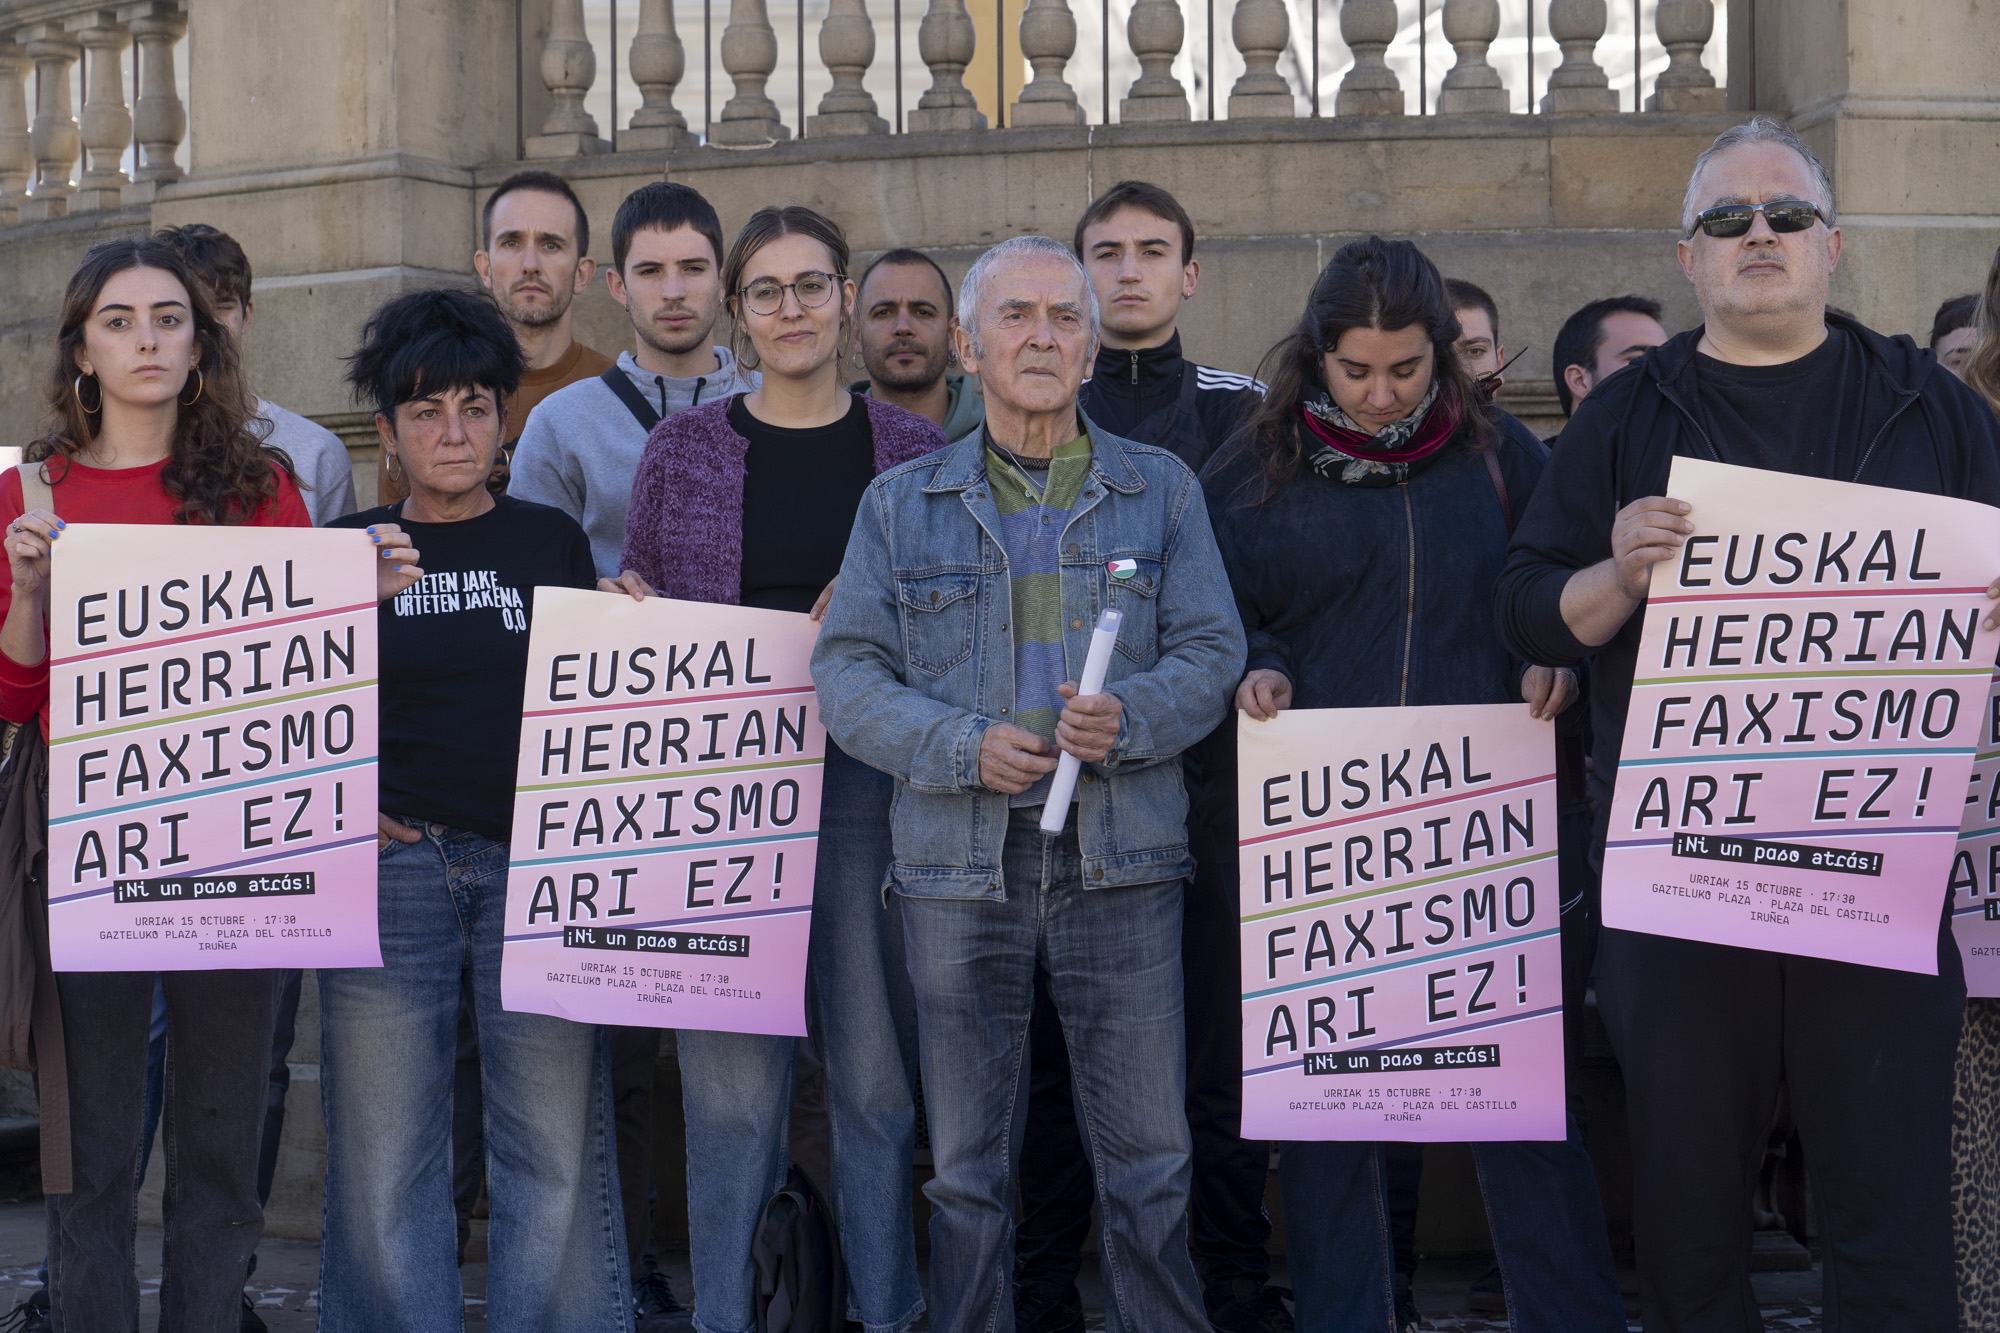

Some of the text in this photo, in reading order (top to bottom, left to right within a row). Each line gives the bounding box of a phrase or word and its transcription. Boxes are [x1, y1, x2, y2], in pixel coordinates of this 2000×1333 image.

[1678, 528, 1941, 588] EUSKAL
[462, 570, 498, 592] JAKE
[77, 559, 314, 647] EUSKAL
[394, 586, 523, 616] URTETEN JAKENA
[1662, 608, 1980, 670] HERRIAN
[75, 625, 354, 727] HERRIAN
[548, 638, 771, 703] EUSKAL
[1651, 688, 1960, 750] FAXISMO
[77, 704, 354, 805] FAXISMO
[541, 705, 807, 777] HERRIAN
[1262, 735, 1492, 828] EUSKAL
[1634, 772, 1763, 831] ARI
[1813, 767, 1933, 821] EZ!
[73, 781, 344, 884] ARI EZ!
[537, 778, 800, 851] FAXISMO
[1263, 798, 1534, 905] HERRIAN
[1677, 835, 1878, 871] ¡Ni un paso atrás!
[118, 874, 311, 901] ¡Ni un paso atrás!
[527, 852, 785, 926] ARI EZ!
[1652, 883, 1890, 924] GAZTELUKO PLAZA PLAZA DEL CASTILLO
[1689, 873, 1855, 905] URRIAK 15 OCTUBRE 17:30
[99, 928, 332, 940] GAZTELUKO PLAZA PLAZA DEL CASTILLO
[135, 915, 296, 926] URRIAK 15 OCTUBRE 17:30
[1267, 876, 1535, 980] FAXISMO
[1750, 911, 1790, 925] IRUÑEA
[198, 940, 237, 950] IRUÑEA
[568, 928, 746, 953] ¡Ni un paso atrás!
[546, 972, 761, 1000] GAZTELUKO PLAZA PLAZA DEL CASTILLO
[581, 962, 729, 984] URRIAK 15 OCTUBRE 17:30
[637, 993, 673, 1004] IRUÑEA
[1265, 953, 1527, 1058] ARI EZ!
[1308, 1046, 1496, 1074] ¡Ni un paso atrás!
[1289, 1101, 1517, 1111] GAZTELUKO PLAZA PLAZA DEL CASTILLO
[1323, 1087, 1482, 1098] URRIAK 15 OCTUBRE 17:30
[1383, 1111, 1422, 1122] IRUÑEA
